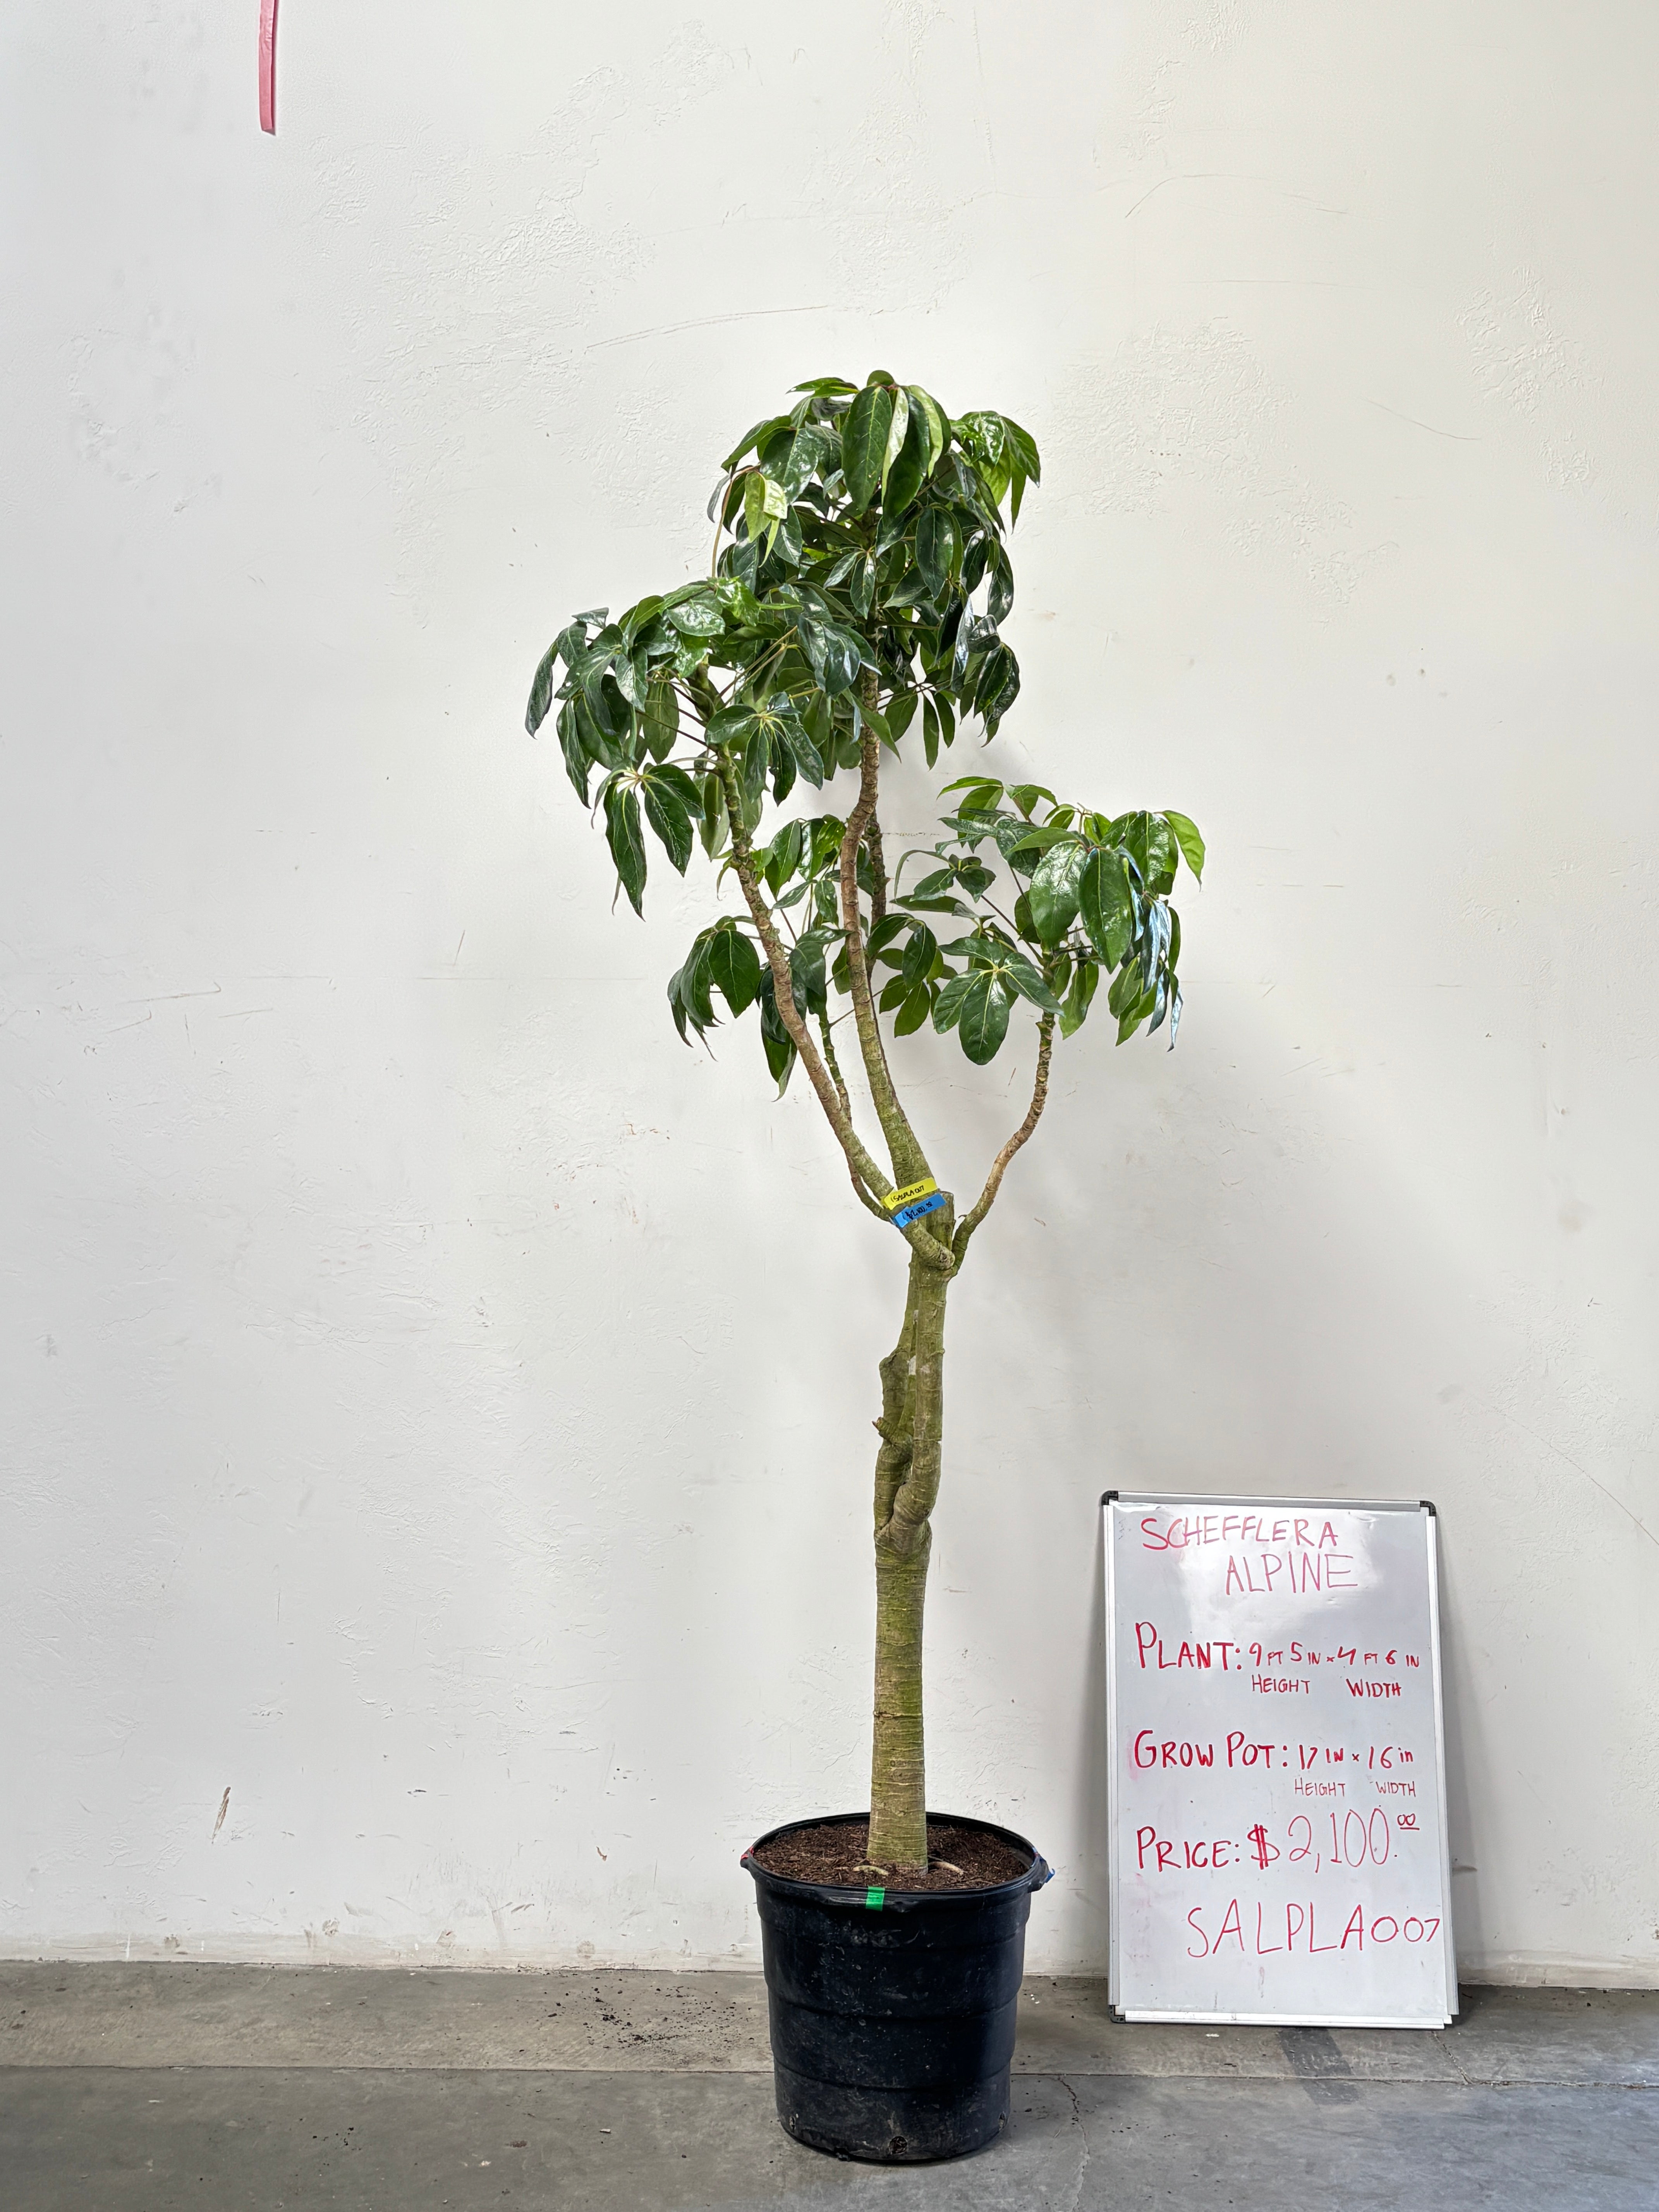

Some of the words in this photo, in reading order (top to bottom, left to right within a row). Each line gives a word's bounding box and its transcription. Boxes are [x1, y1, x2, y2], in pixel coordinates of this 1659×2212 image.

[1140, 1515, 1338, 1551] SCHEFFLERA
[1226, 1551, 1358, 1595] ALPINE
[1135, 1622, 1242, 1671] PLANT:
[1249, 1642, 1262, 1667] 9
[1267, 1651, 1283, 1665] FT
[1290, 1642, 1302, 1662] 5
[1307, 1652, 1320, 1665] IN
[1337, 1647, 1355, 1665] 4
[1364, 1652, 1379, 1664] FT
[1385, 1650, 1396, 1665] 6
[1405, 1655, 1419, 1668] IN
[1252, 1674, 1310, 1694] HEIGHT
[1346, 1679, 1401, 1698] WIDTH
[1133, 1730, 1213, 1769] GROW
[1226, 1731, 1287, 1769] POT:
[1299, 1745, 1318, 1770] 17
[1325, 1748, 1343, 1763] IN
[1369, 1747, 1392, 1769] 16
[1398, 1747, 1413, 1763] in
[1294, 1778, 1345, 1796] HEIGHT
[1376, 1781, 1416, 1797] WIDTH
[1137, 1826, 1239, 1872] PRICE:
[1187, 1899, 1440, 1958] SALPLA007
